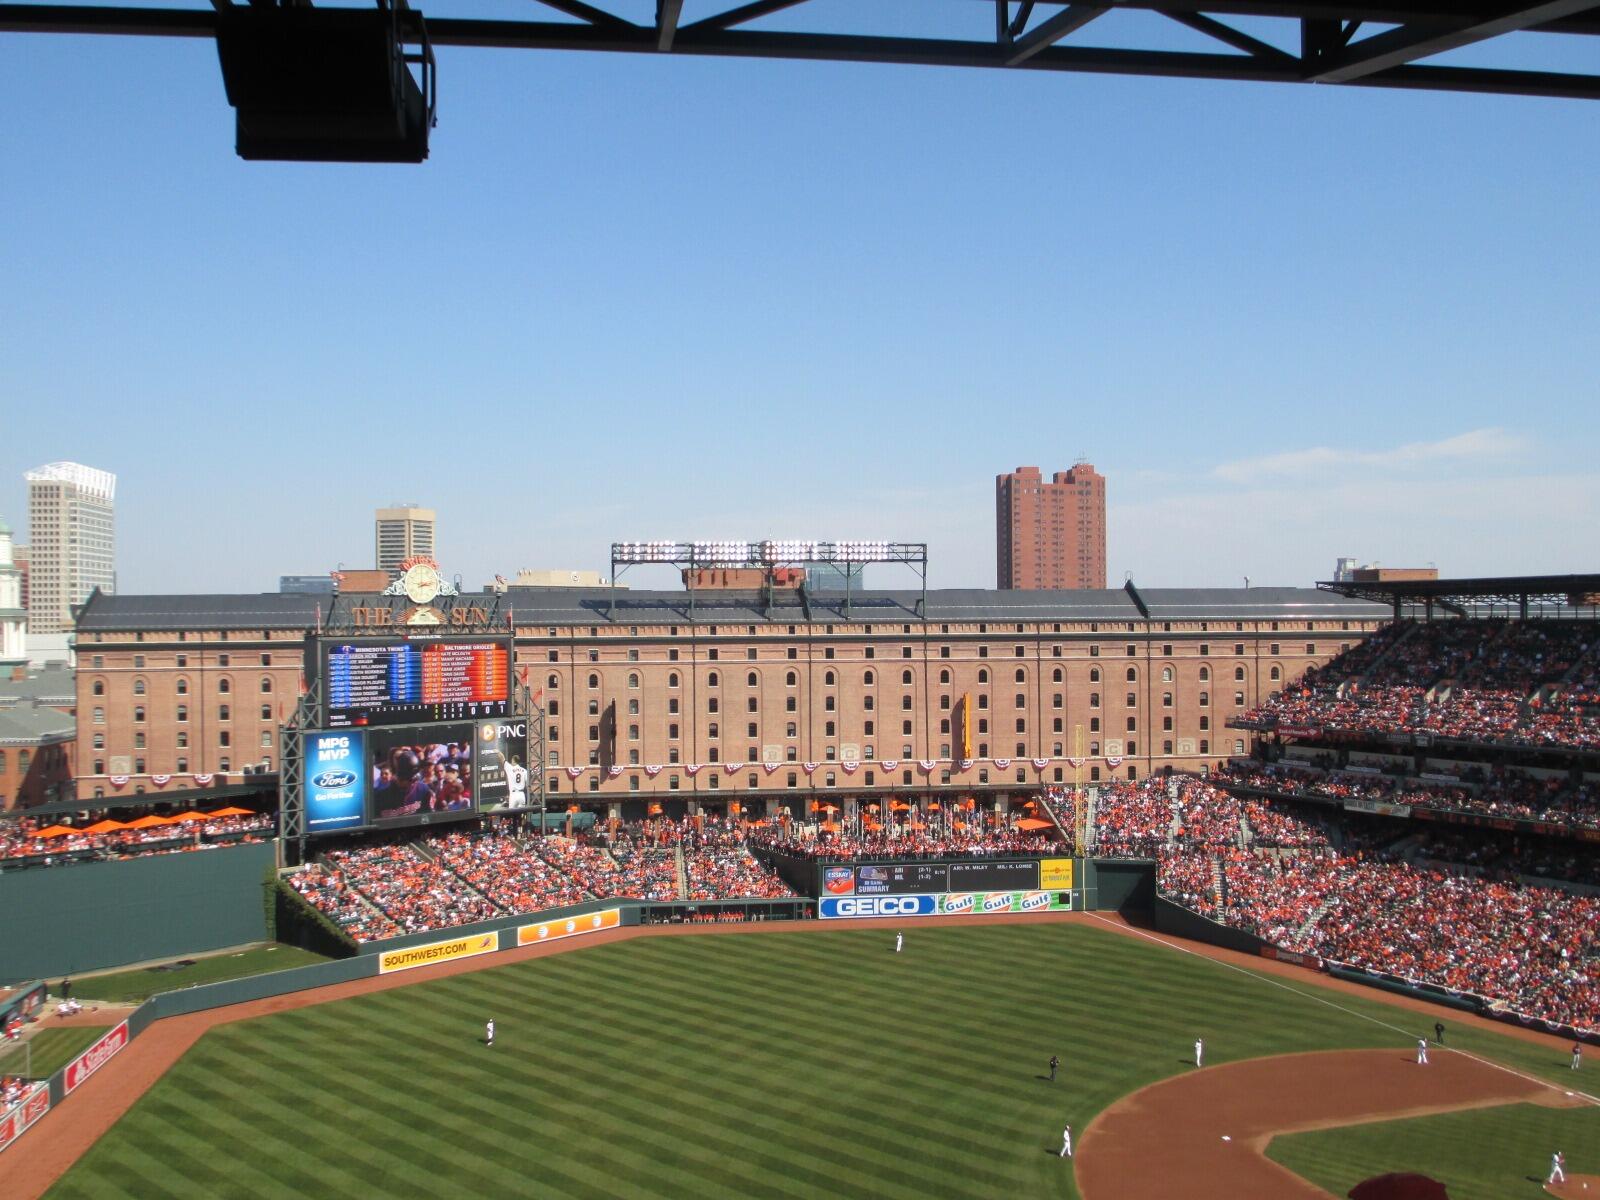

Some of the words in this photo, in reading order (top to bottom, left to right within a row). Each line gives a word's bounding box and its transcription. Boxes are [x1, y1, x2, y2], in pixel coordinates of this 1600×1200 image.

[352, 608, 392, 626] THE
[451, 607, 490, 625] SUN
[498, 724, 525, 738] PNC
[319, 737, 349, 749] MPG
[319, 749, 349, 761] MVP
[320, 772, 349, 786] Ford
[516, 773, 521, 783] 8
[837, 897, 919, 915] GEICO
[946, 895, 973, 911] Gulf
[984, 895, 1012, 910] Gulf
[1022, 893, 1050, 909] Gulf
[384, 943, 467, 966] SOUTHWEST.COM
